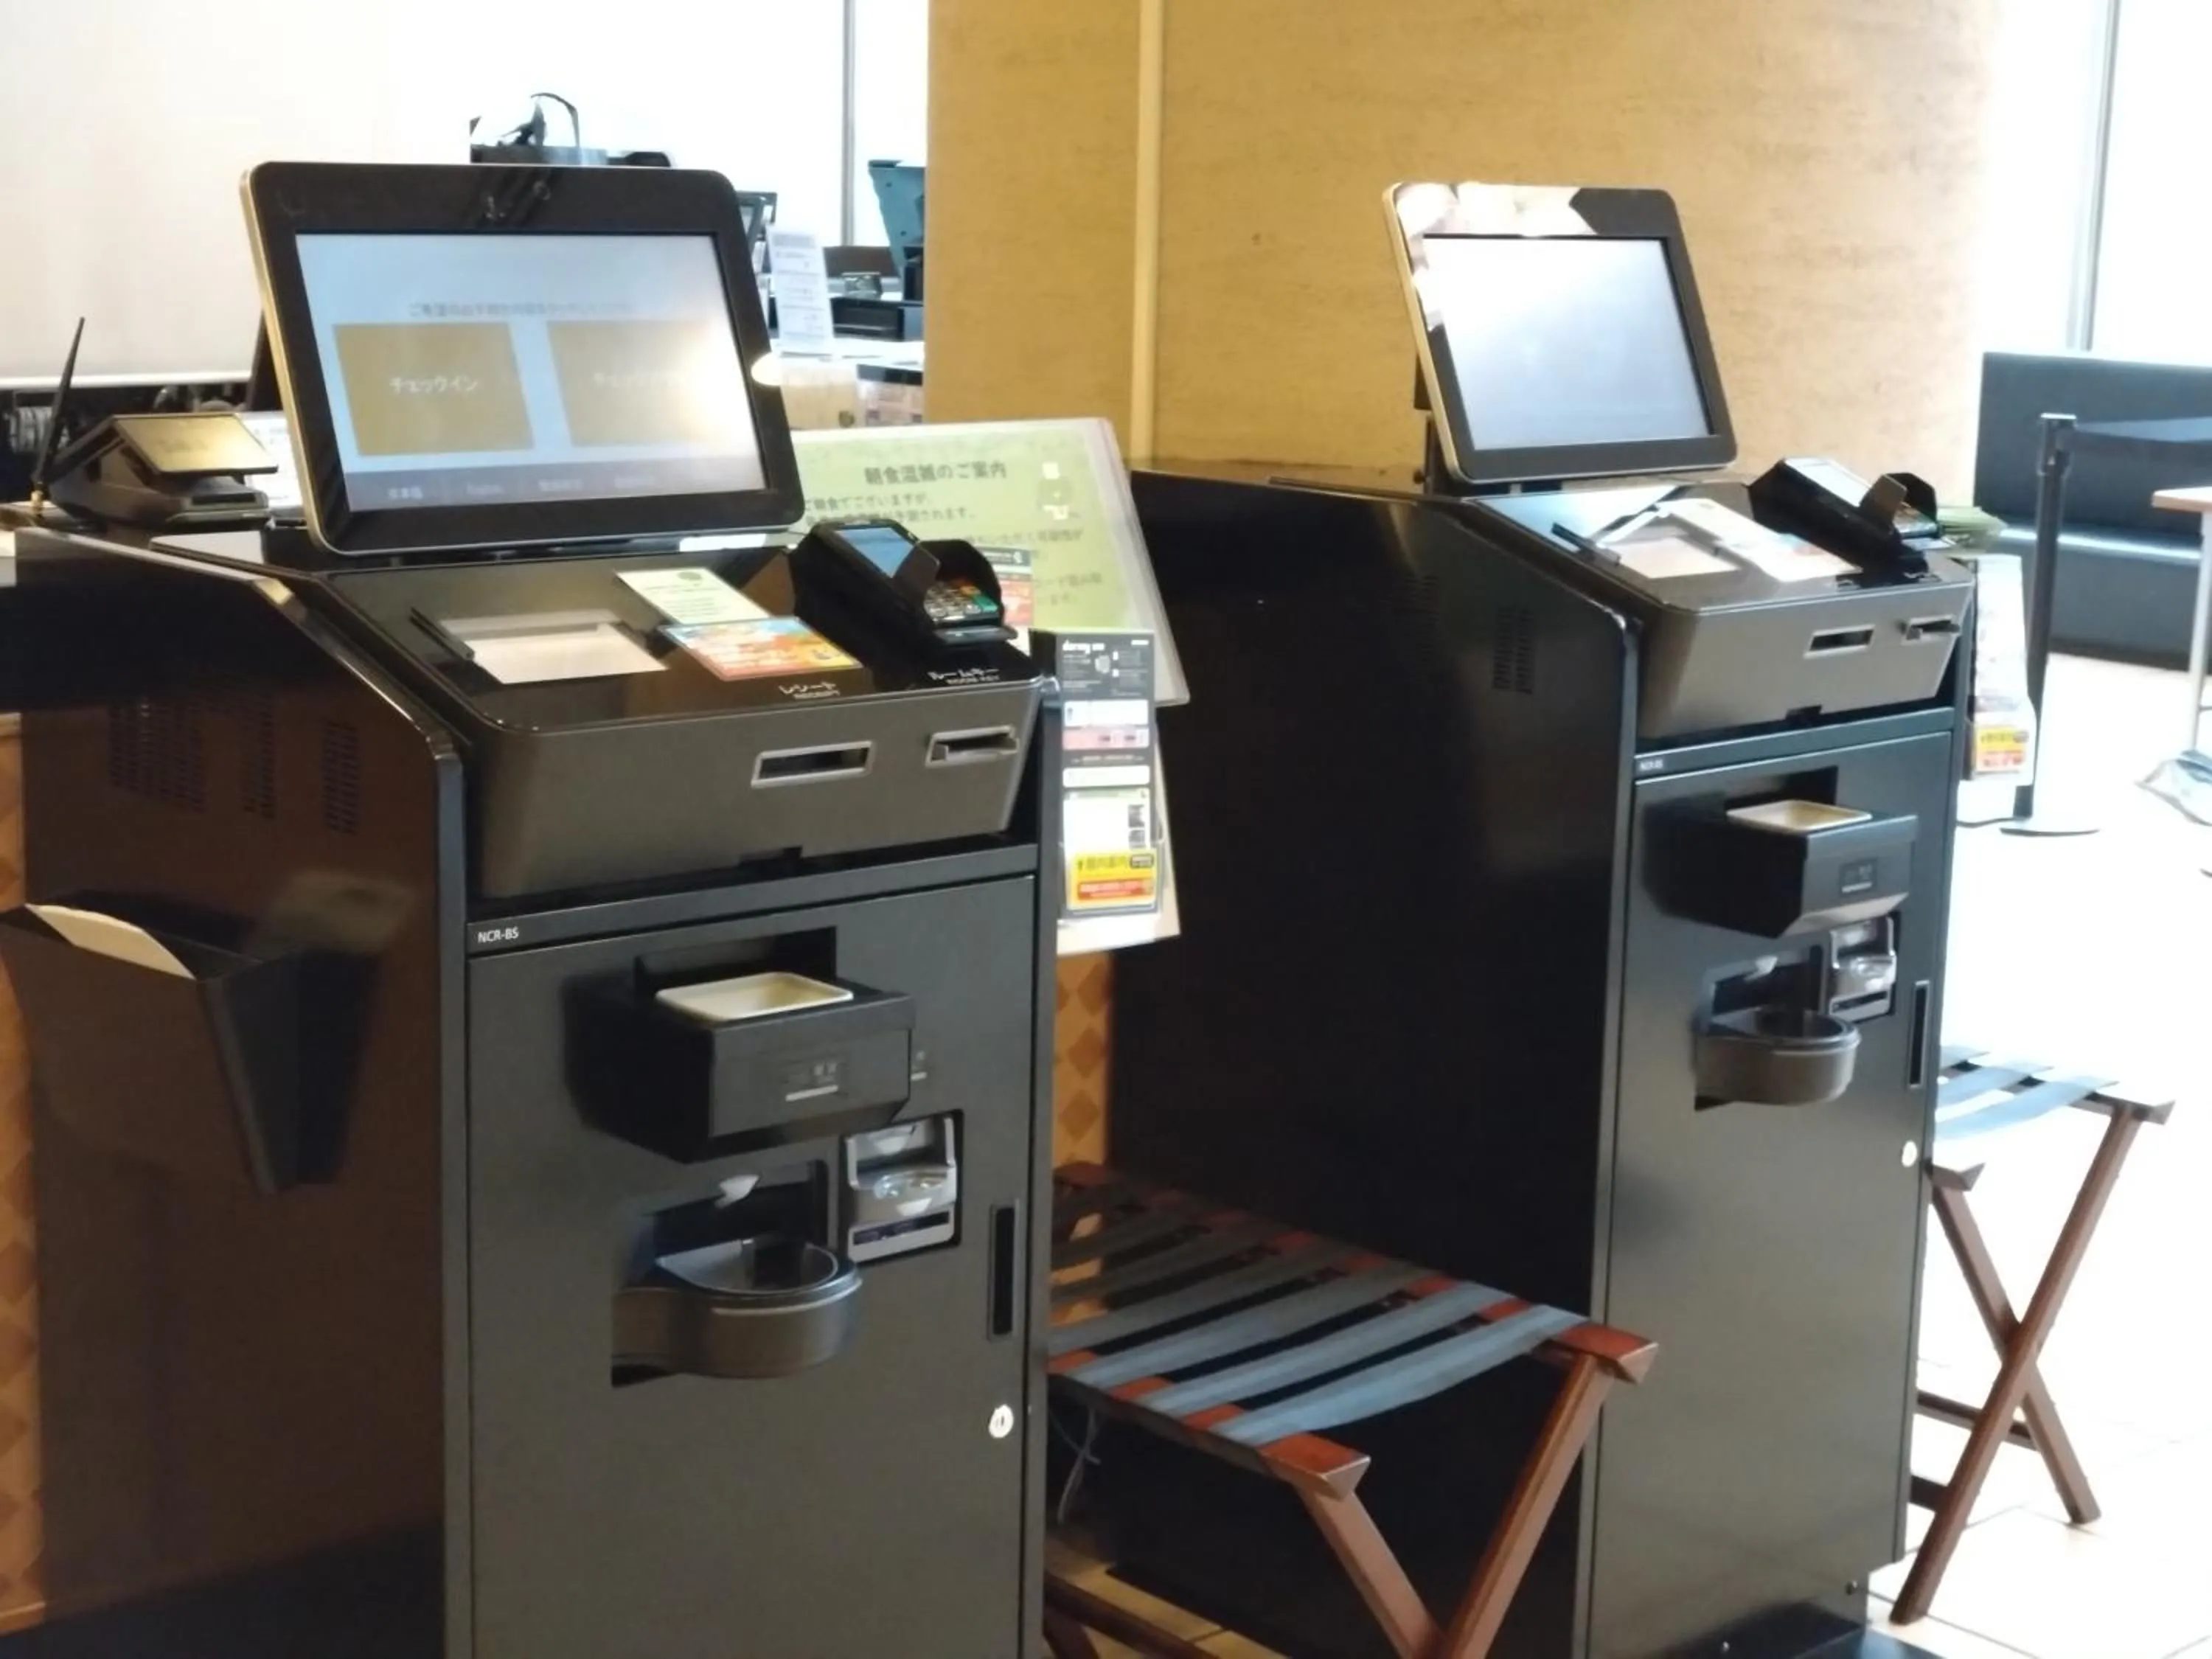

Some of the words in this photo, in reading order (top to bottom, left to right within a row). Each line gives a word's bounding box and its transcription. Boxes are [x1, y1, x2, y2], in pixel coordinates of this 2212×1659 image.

[389, 375, 479, 395] チェックイン
[477, 925, 520, 944] NCR-BS
